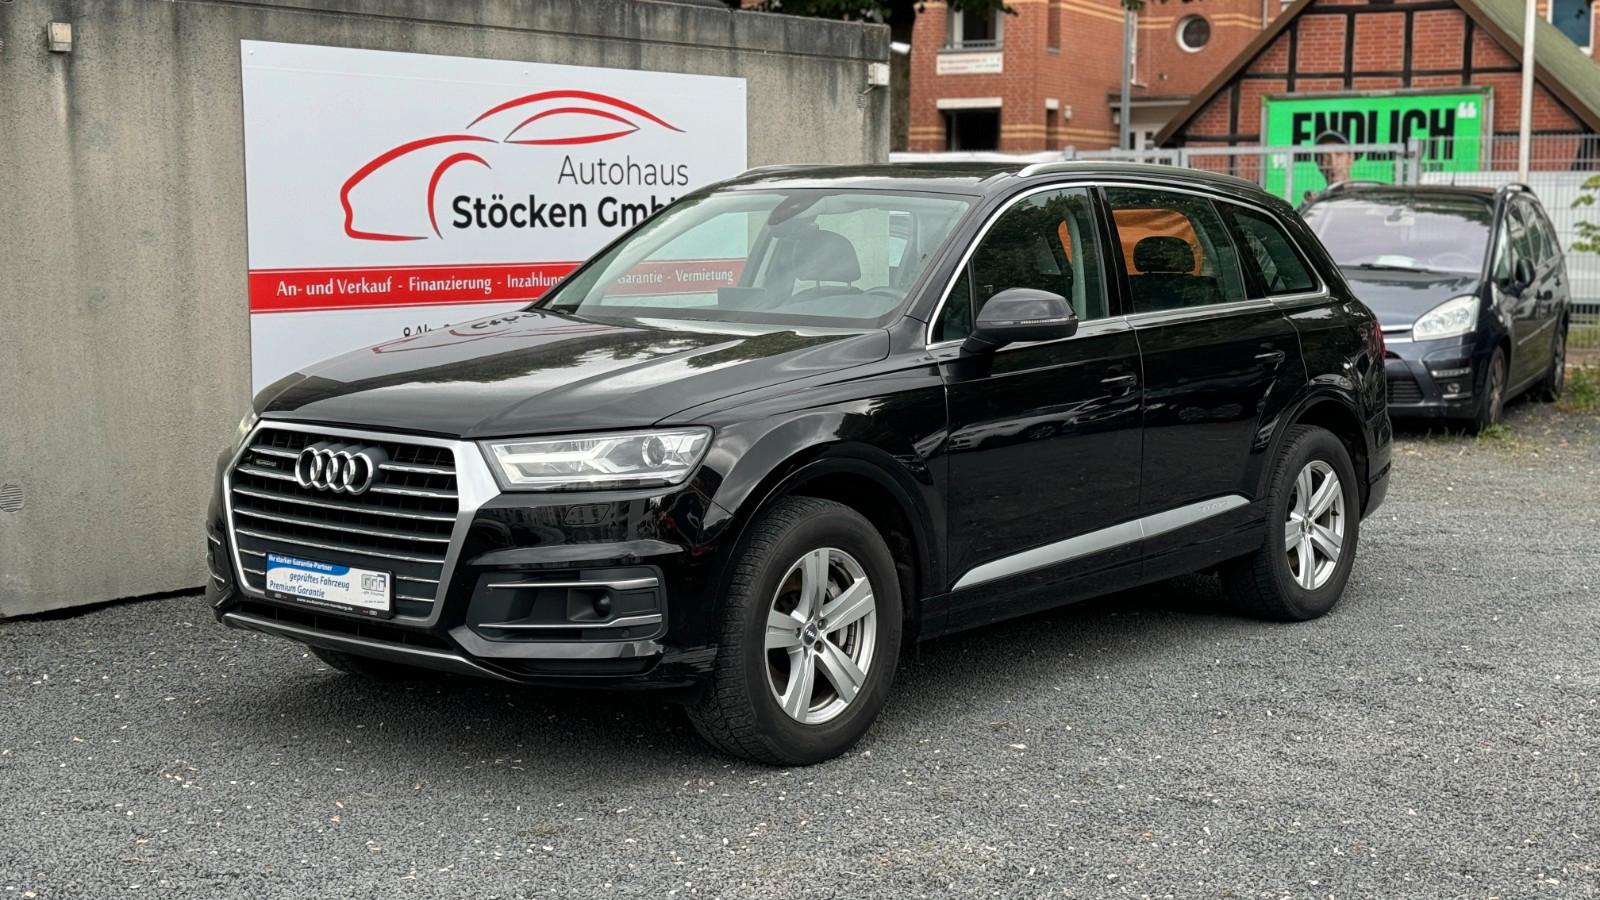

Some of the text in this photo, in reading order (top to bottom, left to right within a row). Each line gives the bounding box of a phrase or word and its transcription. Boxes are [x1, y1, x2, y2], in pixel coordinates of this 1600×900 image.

[557, 155, 689, 186] Autohaus
[452, 193, 676, 229] Stöcken Gmb
[276, 280, 303, 297] An-
[306, 277, 334, 295] und
[337, 276, 393, 294] Verkauf
[408, 275, 492, 294] Finanzierung
[675, 268, 734, 285] Vermietung
[269, 579, 326, 598] Premium Garantie
[289, 571, 350, 592] geprüftes Fahrzeug
